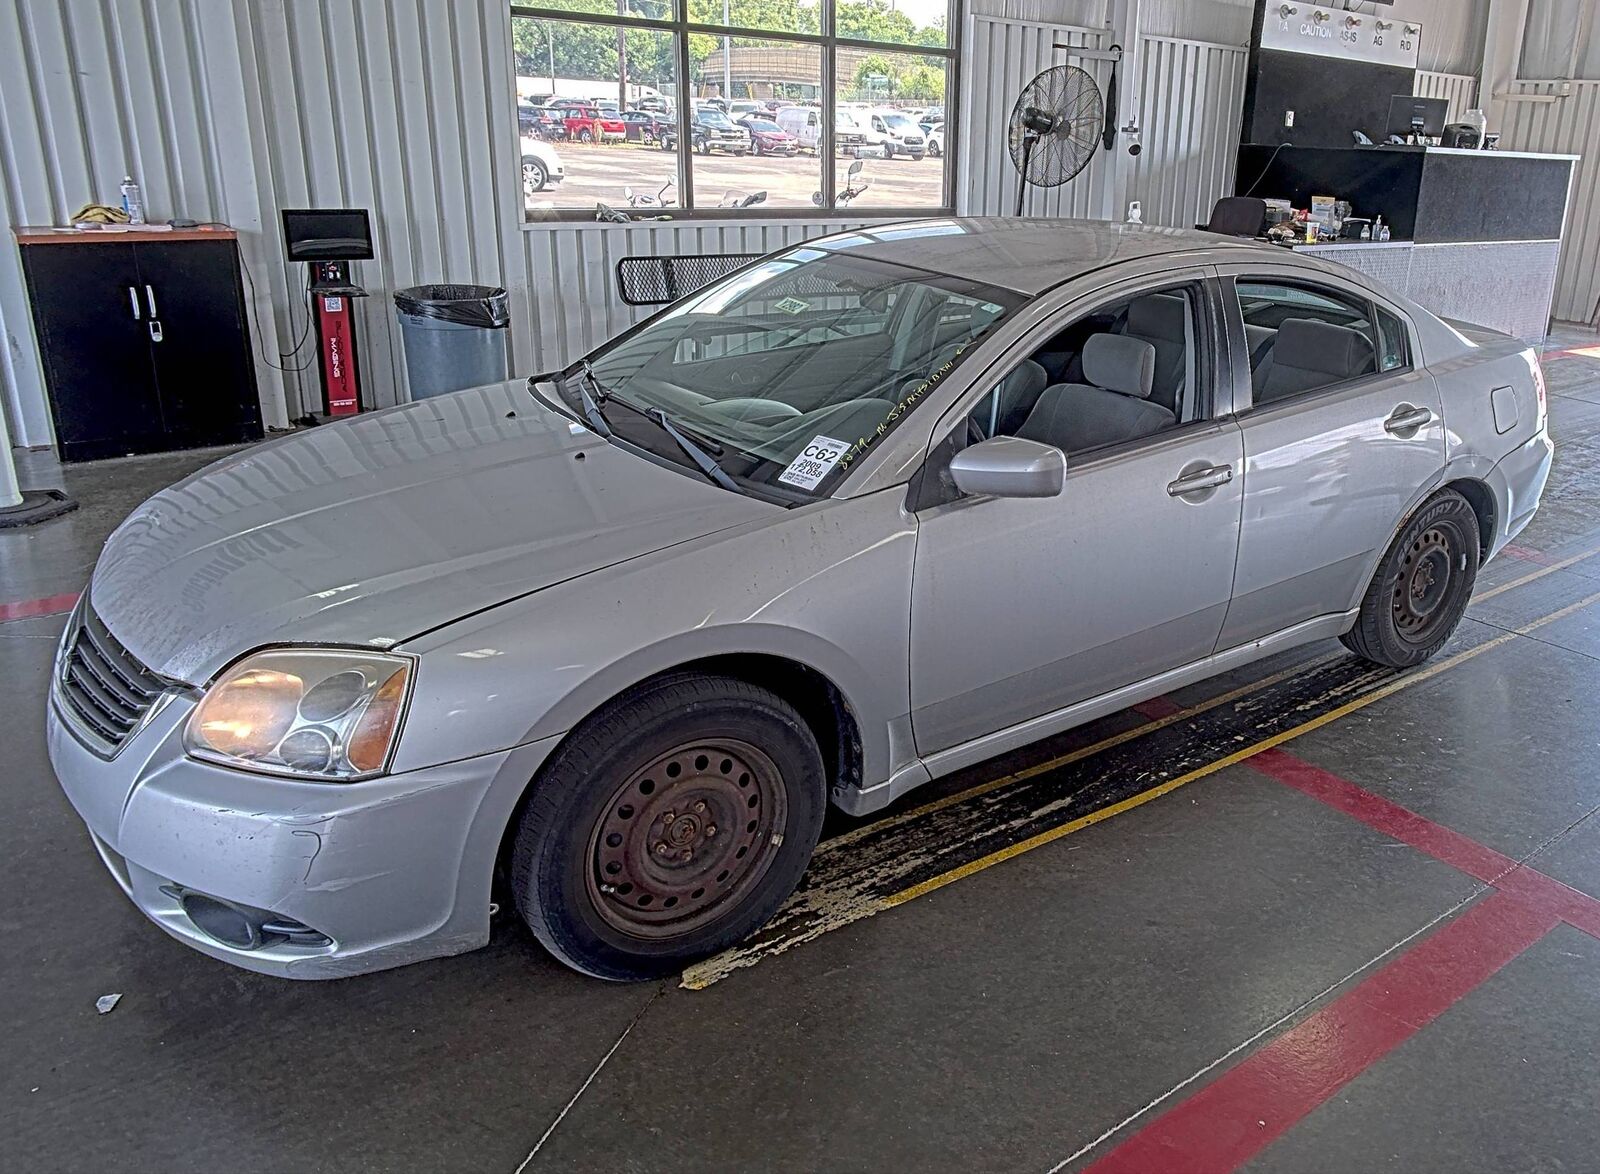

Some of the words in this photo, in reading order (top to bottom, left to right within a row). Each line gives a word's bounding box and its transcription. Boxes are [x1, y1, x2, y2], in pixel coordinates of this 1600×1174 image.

[1300, 23, 1332, 39] CAUTION
[1340, 30, 1357, 43] AS-IS
[1373, 36, 1383, 46] AG
[803, 445, 838, 463] C62
[790, 463, 823, 478] 172,058
[800, 459, 822, 469] 2009
